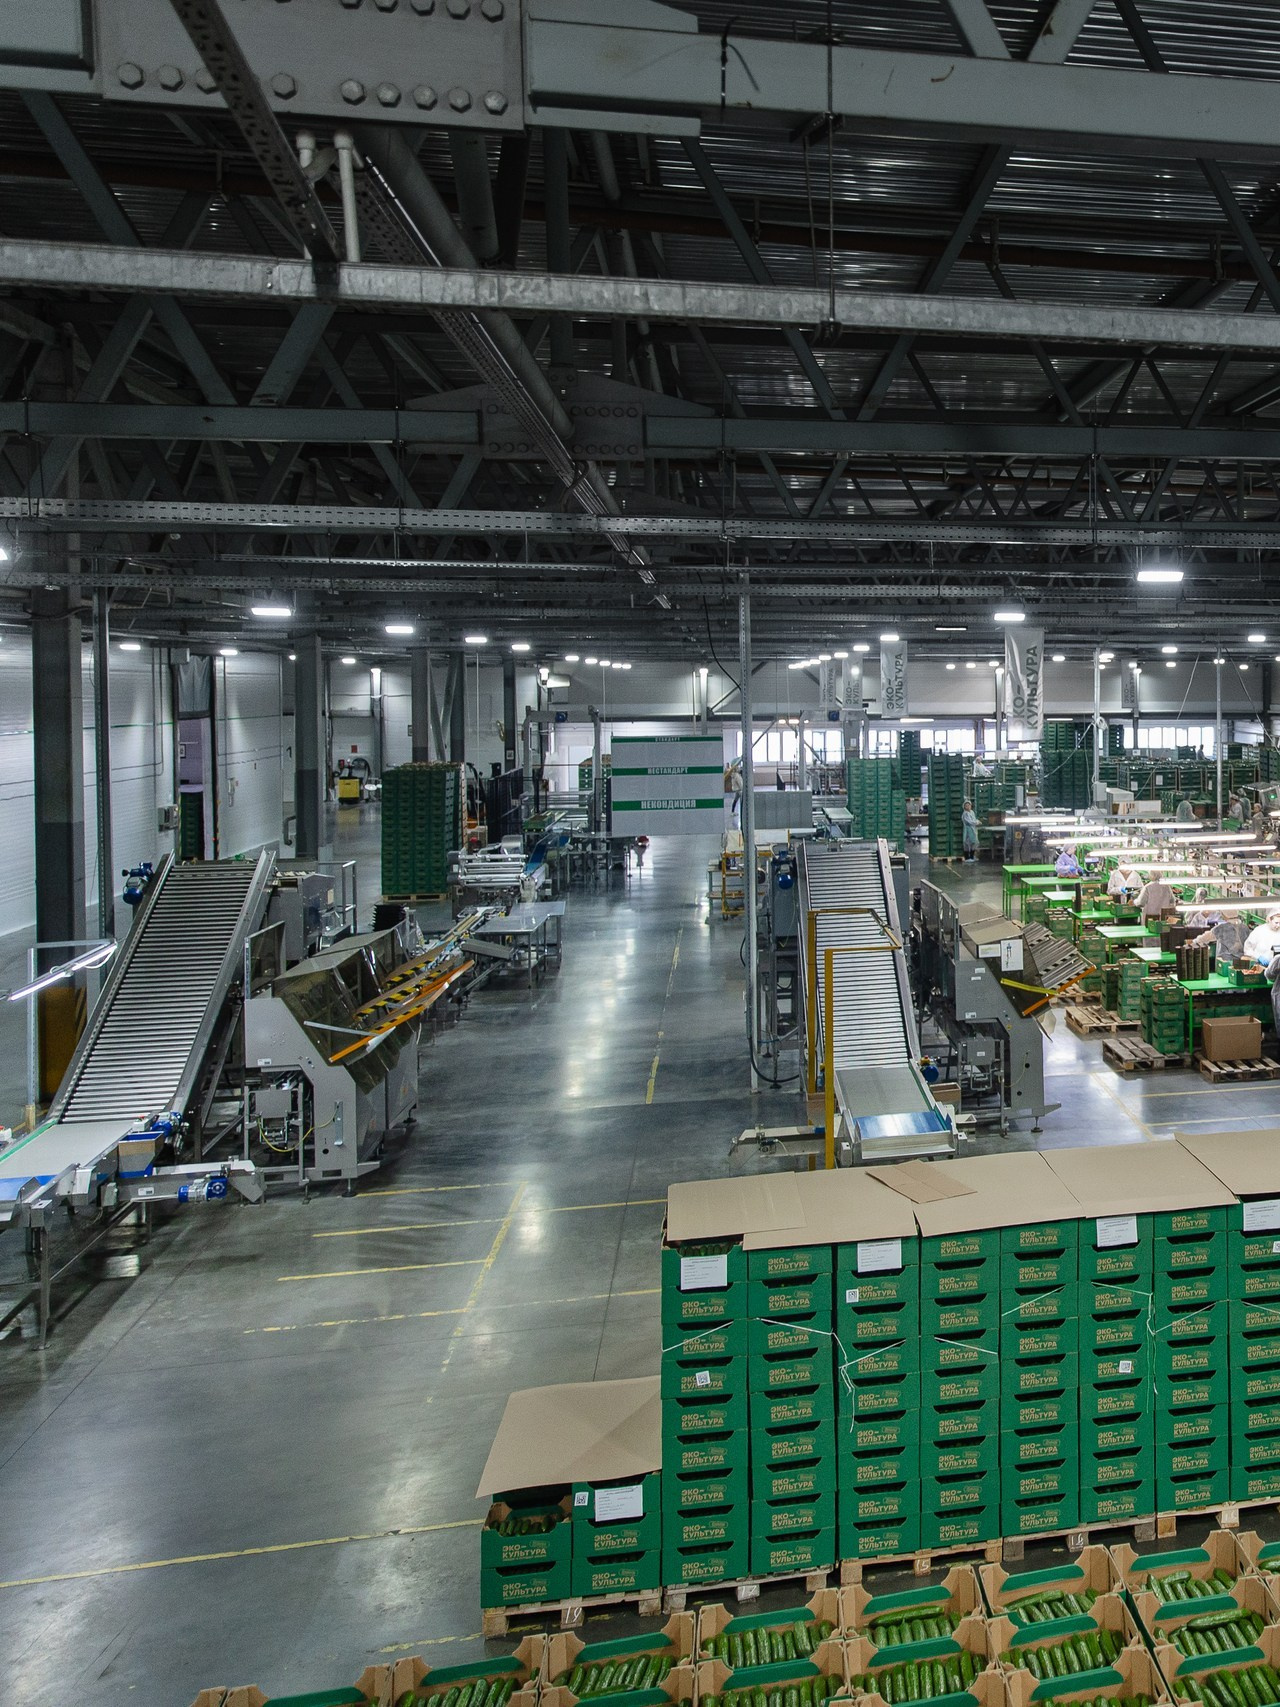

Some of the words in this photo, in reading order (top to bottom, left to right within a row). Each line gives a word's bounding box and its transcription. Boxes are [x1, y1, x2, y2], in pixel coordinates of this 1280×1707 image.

[895, 653, 904, 709] КУЛЬТУРА
[1026, 645, 1038, 730] КУЛЬТУРА
[886, 679, 894, 710] ЭКО-
[648, 767, 689, 775] НЕСТАНДАРТ
[641, 800, 696, 810] НЕКОНДИЦИЯ
[1172, 1219, 1208, 1229] КУЛЬТУРА
[1020, 1235, 1058, 1245] КУЛЬТУРА
[941, 1244, 980, 1255] КУЛЬТУРА
[768, 1260, 809, 1272] КУЛЬТУРА
[1097, 1261, 1134, 1271] КУЛЬТУРА
[1246, 1281, 1280, 1291] КУЛЬТУРА
[769, 1297, 810, 1309] КУЛЬТУРА
[683, 1305, 724, 1315] КУЛЬТУРА
[940, 1315, 979, 1326] КУЛЬТУРА
[858, 1325, 898, 1335] КУЛЬТУРА
[1172, 1357, 1208, 1367] КУЛЬТУРА
[1020, 1376, 1058, 1386] КУЛЬТУРА
[859, 1397, 899, 1407] КУЛЬТУРА
[1098, 1400, 1135, 1410] КУЛЬТУРА
[771, 1407, 812, 1419] КУЛЬТУРА
[682, 1417, 723, 1427] КУЛЬТУРА
[939, 1422, 978, 1433] КУЛЬТУРА
[1020, 1446, 1058, 1456] КУЛЬТУРА
[1173, 1459, 1209, 1469] КУЛЬТУРА
[858, 1469, 898, 1479] КУЛЬТУРА
[1098, 1469, 1135, 1479] КУЛЬТУРА
[772, 1480, 813, 1492] КУЛЬТУРА
[682, 1492, 723, 1502] КУЛЬТУРА
[941, 1493, 980, 1504] КУЛЬТУРА
[1020, 1517, 1058, 1527] КУЛЬТУРА
[594, 1537, 638, 1548] КУЛЬТУРА
[859, 1539, 899, 1549] КУЛЬТУРА
[503, 1548, 547, 1558] КУЛЬТУРА
[683, 1566, 724, 1576] КУЛЬТУРА
[592, 1576, 636, 1587] КУЛЬТУРА
[503, 1586, 547, 1596] КУЛЬТУРА
[565, 1606, 582, 1624] 19
